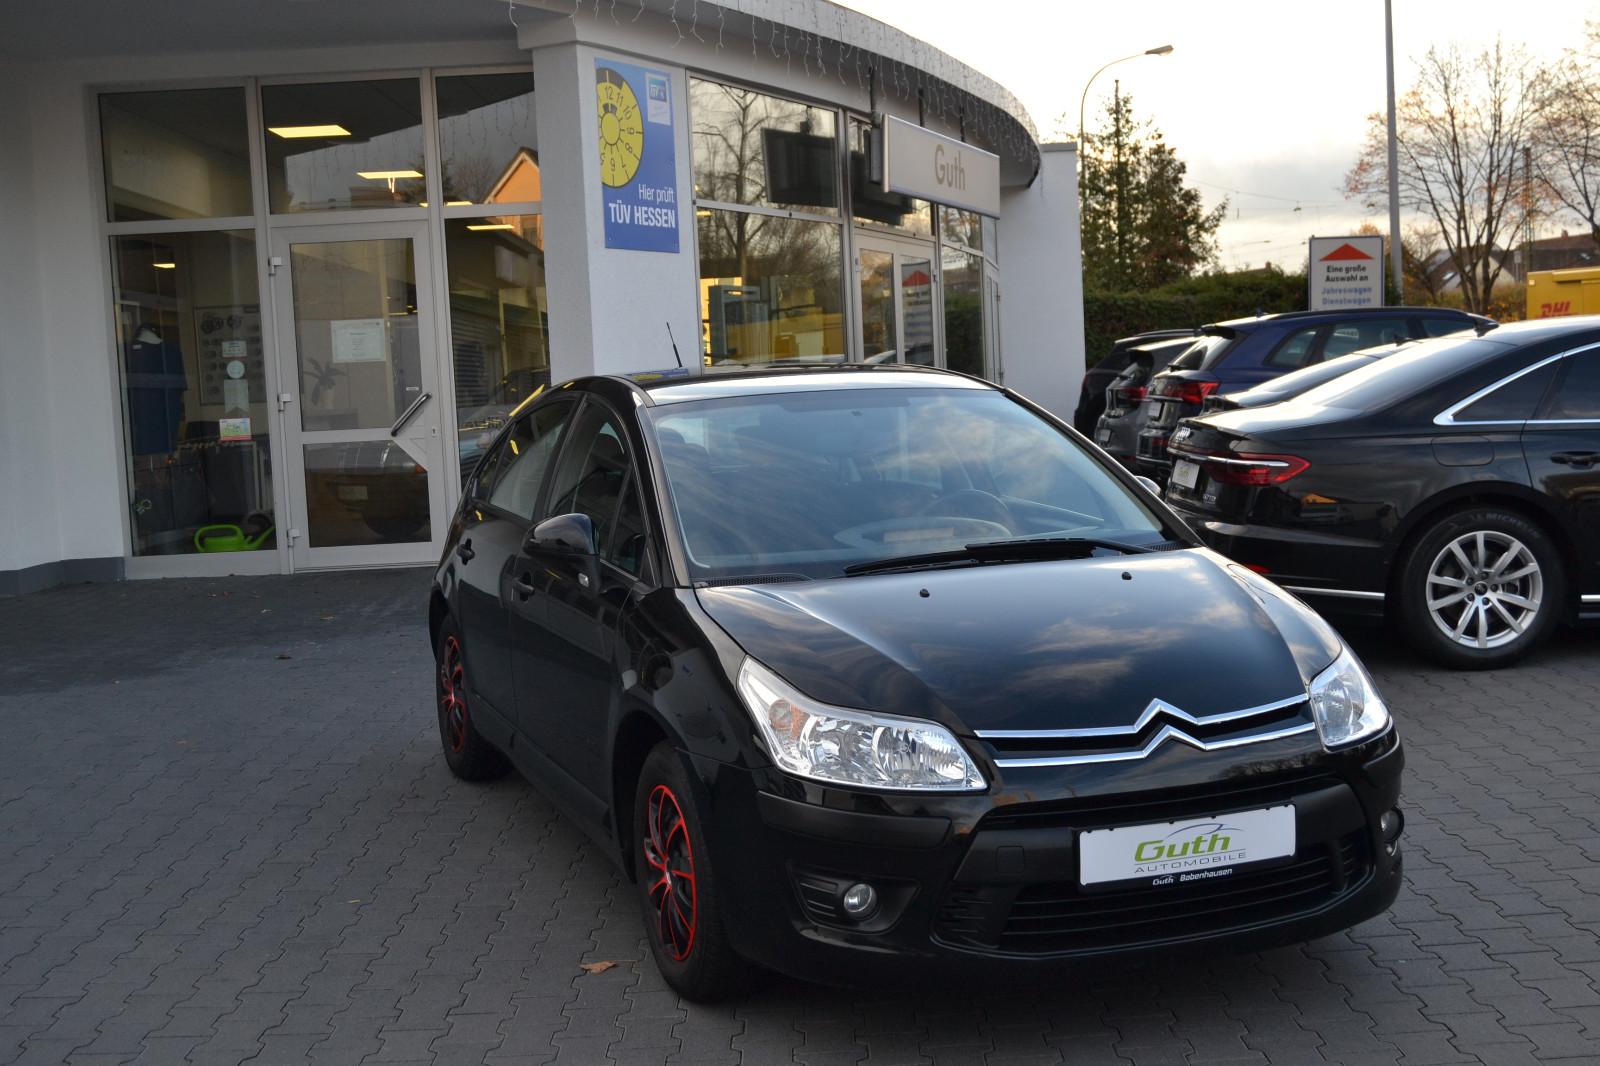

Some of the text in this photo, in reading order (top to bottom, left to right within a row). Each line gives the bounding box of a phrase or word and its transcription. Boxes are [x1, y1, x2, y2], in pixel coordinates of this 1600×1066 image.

[605, 86, 613, 100] 12
[623, 105, 632, 120] 10
[624, 142, 633, 153] 8
[935, 144, 965, 190] Guth
[639, 184, 675, 205] Hier prüft
[609, 200, 676, 228] TÜV HESSEN
[1345, 265, 1366, 274] große
[1134, 833, 1231, 862] Guth
[1134, 852, 1246, 874] AUTOMOBILE
[1152, 868, 1233, 886] Guth Babenhausen
